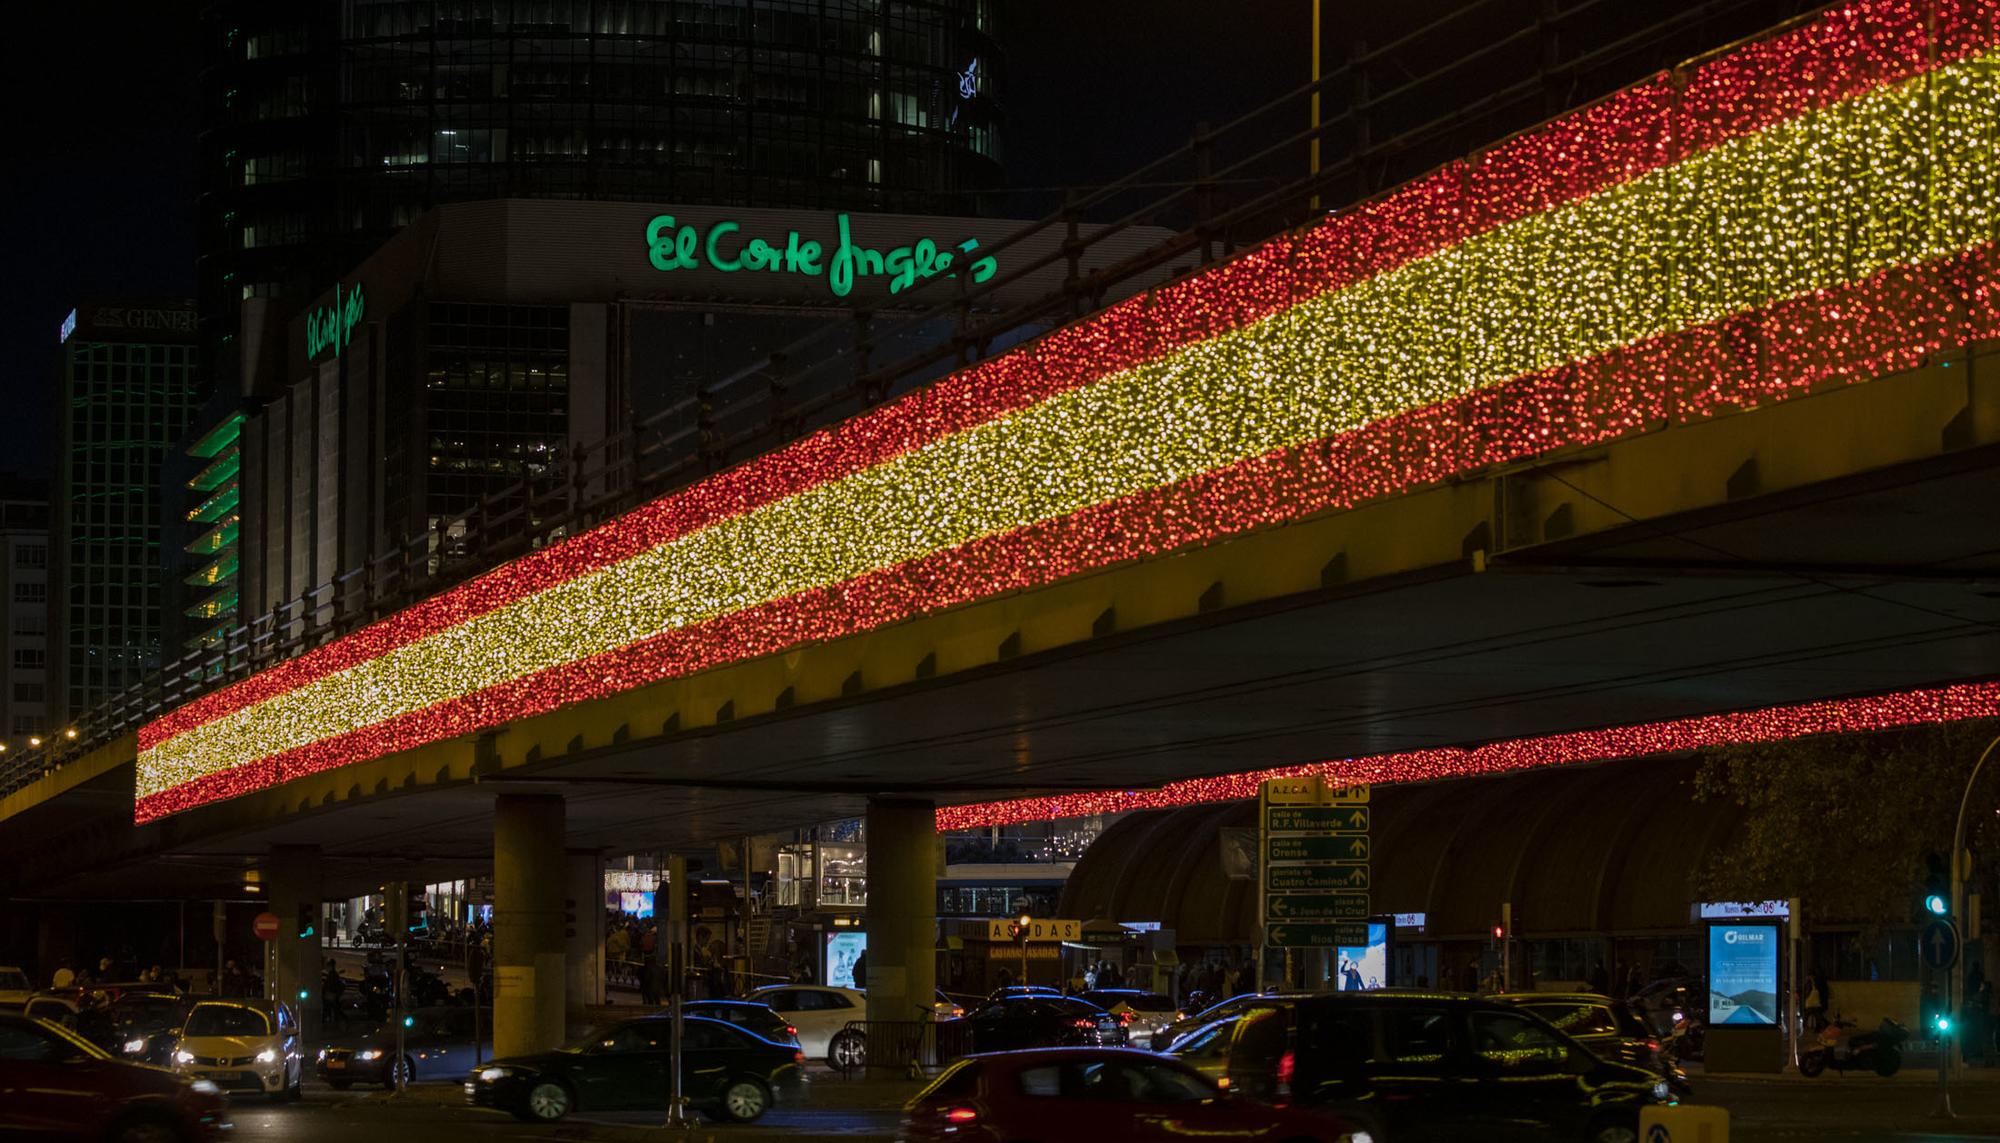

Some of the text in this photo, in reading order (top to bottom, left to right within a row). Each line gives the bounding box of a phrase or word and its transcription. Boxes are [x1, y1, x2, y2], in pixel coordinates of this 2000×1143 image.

[645, 213, 700, 273] El
[703, 220, 824, 277] Corte
[1293, 818, 1344, 829] Villaverde
[1272, 848, 1309, 857] Orense
[1272, 877, 1349, 887] Cuatro Caminos
[993, 924, 1073, 937] ASDAS
